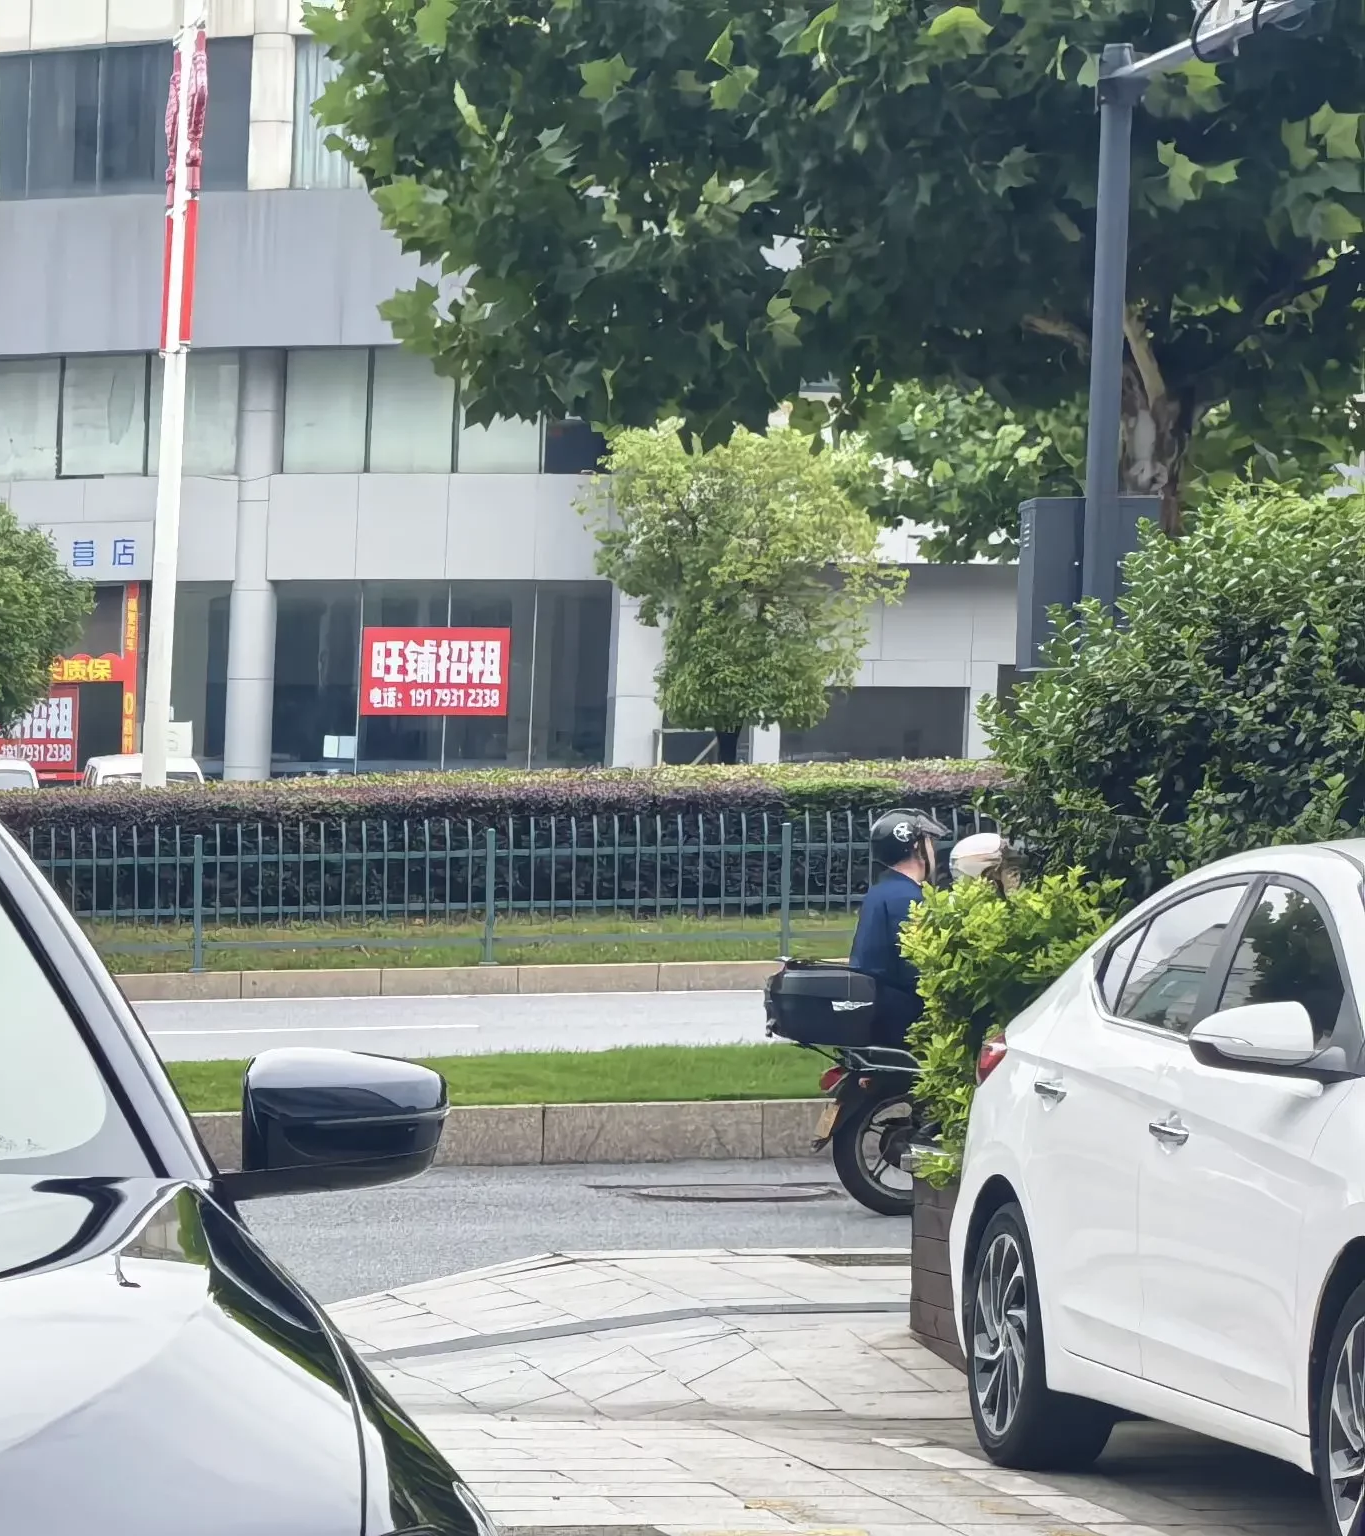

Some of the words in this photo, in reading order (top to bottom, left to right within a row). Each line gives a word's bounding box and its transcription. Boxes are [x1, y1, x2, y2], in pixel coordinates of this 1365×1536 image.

[371, 639, 502, 684] 旺铺招租
[409, 688, 432, 707] 191
[434, 688, 465, 707] 7931
[467, 688, 501, 707] 2338
[20, 744, 45, 760] 7931
[46, 744, 72, 761] 2338
